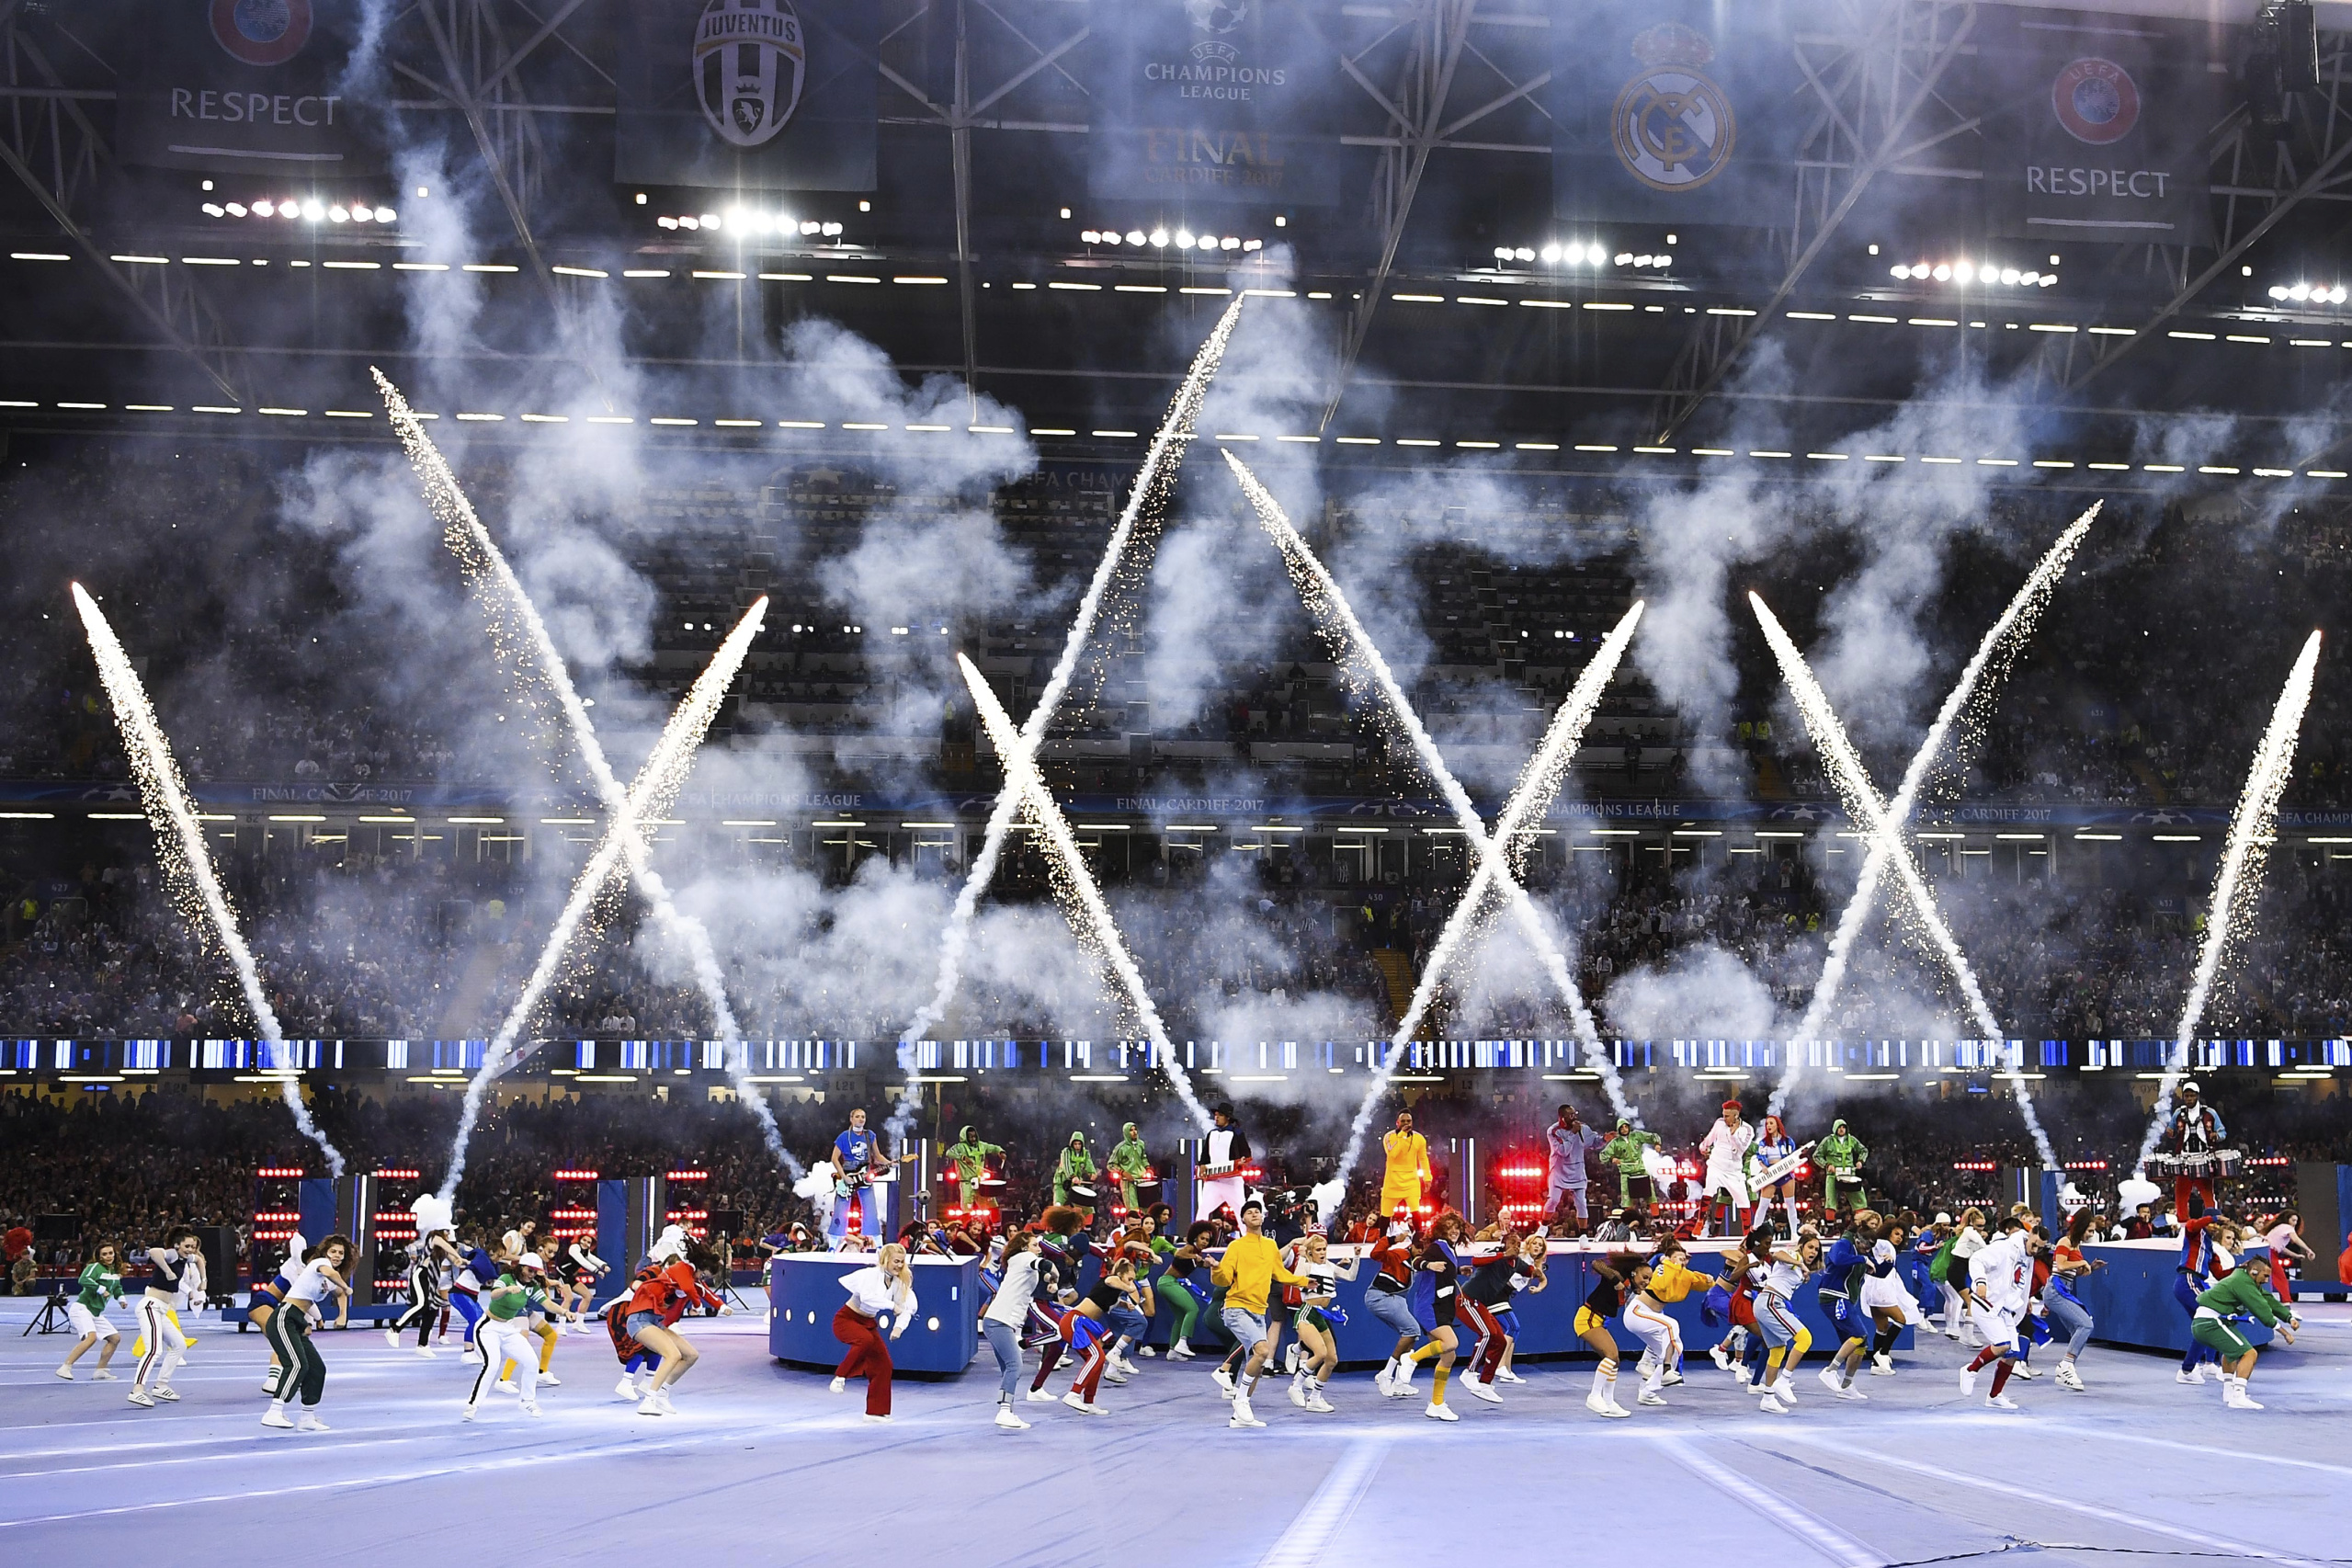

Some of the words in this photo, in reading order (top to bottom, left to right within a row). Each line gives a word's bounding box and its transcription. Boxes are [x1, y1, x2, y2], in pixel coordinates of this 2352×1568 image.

[703, 13, 796, 42] JUVENTUS
[1191, 43, 1236, 62] UEFA
[1144, 62, 1286, 86] CHAMPIONS
[2069, 62, 2119, 84] UEFA
[1180, 85, 1251, 101] LEAGUE
[171, 87, 342, 127] RESPECT
[1142, 127, 1285, 166] FINAL
[2027, 165, 2170, 199] RESPECT
[253, 788, 300, 801] FINAL
[380, 790, 413, 802] 2017
[712, 793, 800, 807] CHAMPIONS
[806, 794, 861, 807] LEAGUE
[1116, 798, 1161, 811] FINAL
[1166, 799, 1230, 812] CARDIFF
[1234, 800, 1265, 812] 2017
[1544, 803, 1623, 817] HAMPIONS
[1628, 804, 1680, 817] LEAGUE
[1959, 808, 2019, 821] CARDIFF
[2024, 809, 2051, 822] 2017
[51, 883, 68, 892] 427
[1368, 893, 1383, 902] 430
